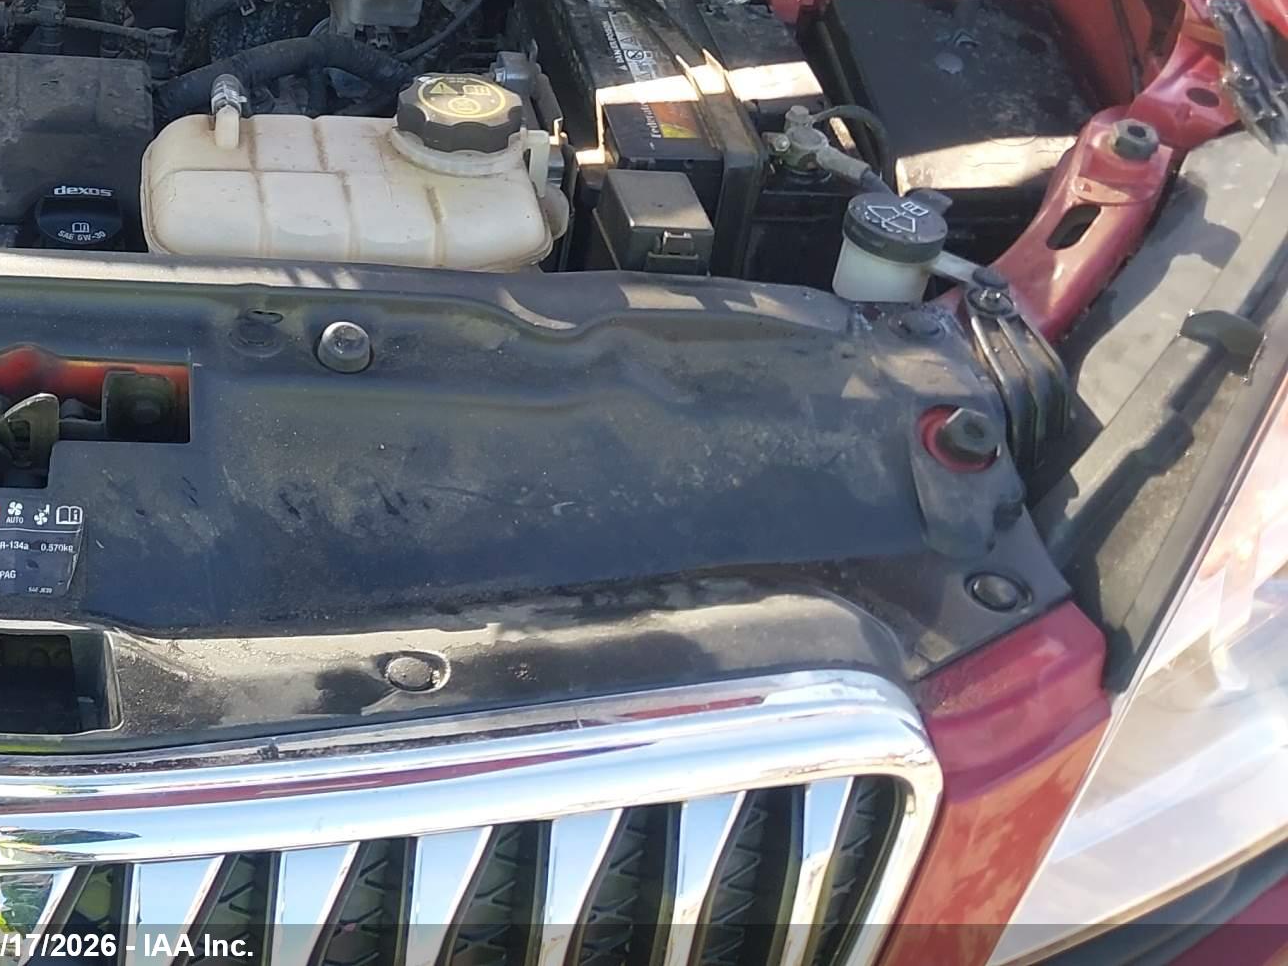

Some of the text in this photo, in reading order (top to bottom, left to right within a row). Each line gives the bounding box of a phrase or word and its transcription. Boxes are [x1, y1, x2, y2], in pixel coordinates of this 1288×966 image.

[53, 185, 113, 197] dexos
[57, 229, 75, 241] SAE
[5, 515, 25, 524] AUTO
[0, 540, 74, 553] R-134a 0.570kg
[0, 570, 17, 580] PAG
